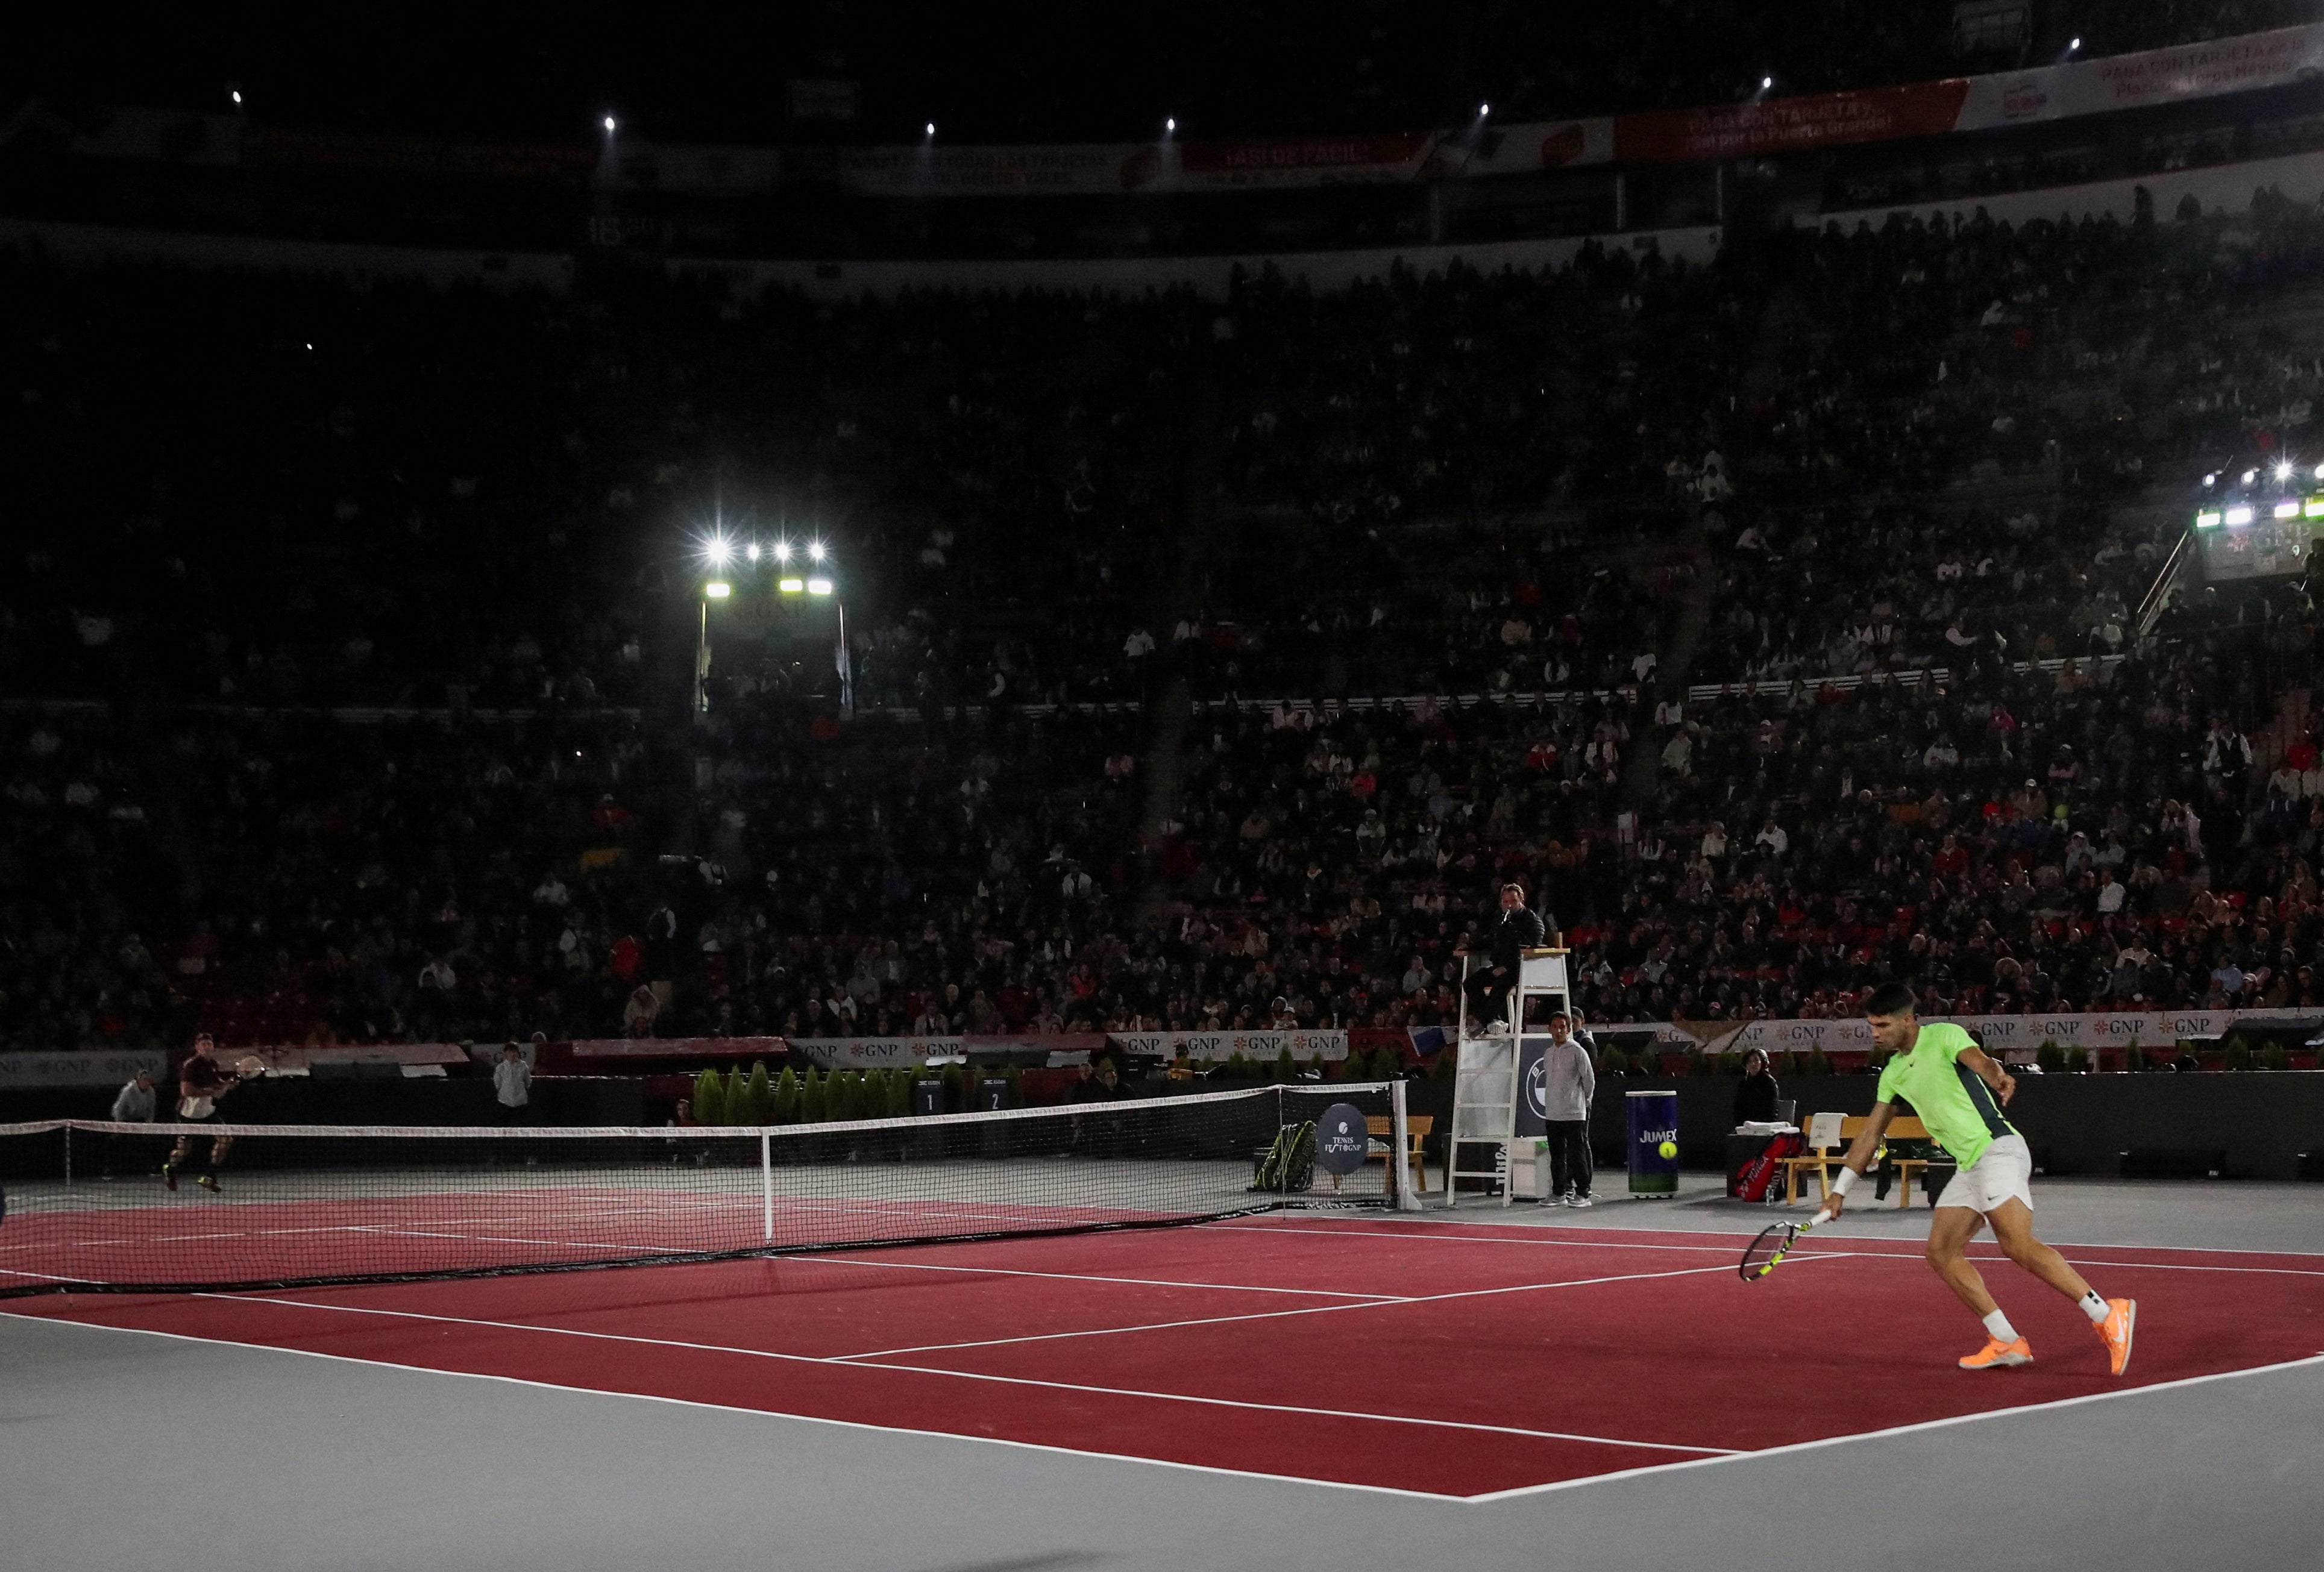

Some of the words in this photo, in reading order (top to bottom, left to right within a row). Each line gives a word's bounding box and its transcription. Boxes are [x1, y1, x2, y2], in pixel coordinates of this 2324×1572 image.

[2188, 45, 2264, 68] TARJETA
[1777, 102, 1858, 126] TARJETA
[1768, 124, 1823, 140] Puerta
[1741, 1028, 1762, 1041] NP
[1792, 1026, 1824, 1039] GNP
[1982, 1022, 2014, 1035] GNP
[2045, 1021, 2079, 1035] GNP
[2110, 1019, 2144, 1033] GNP
[2175, 1018, 2210, 1032] GNP
[805, 1045, 837, 1057] GNP
[865, 1045, 897, 1056] GNP
[926, 1044, 958, 1055] GNP
[1128, 1039, 1160, 1050] GNP
[1188, 1038, 1219, 1050] GNP
[1249, 1037, 1280, 1049] GNP
[1308, 1036, 1340, 1048] GNP
[927, 1094, 933, 1110] 1
[991, 1093, 999, 1110] 2
[1639, 1128, 1678, 1144] JUMEX
